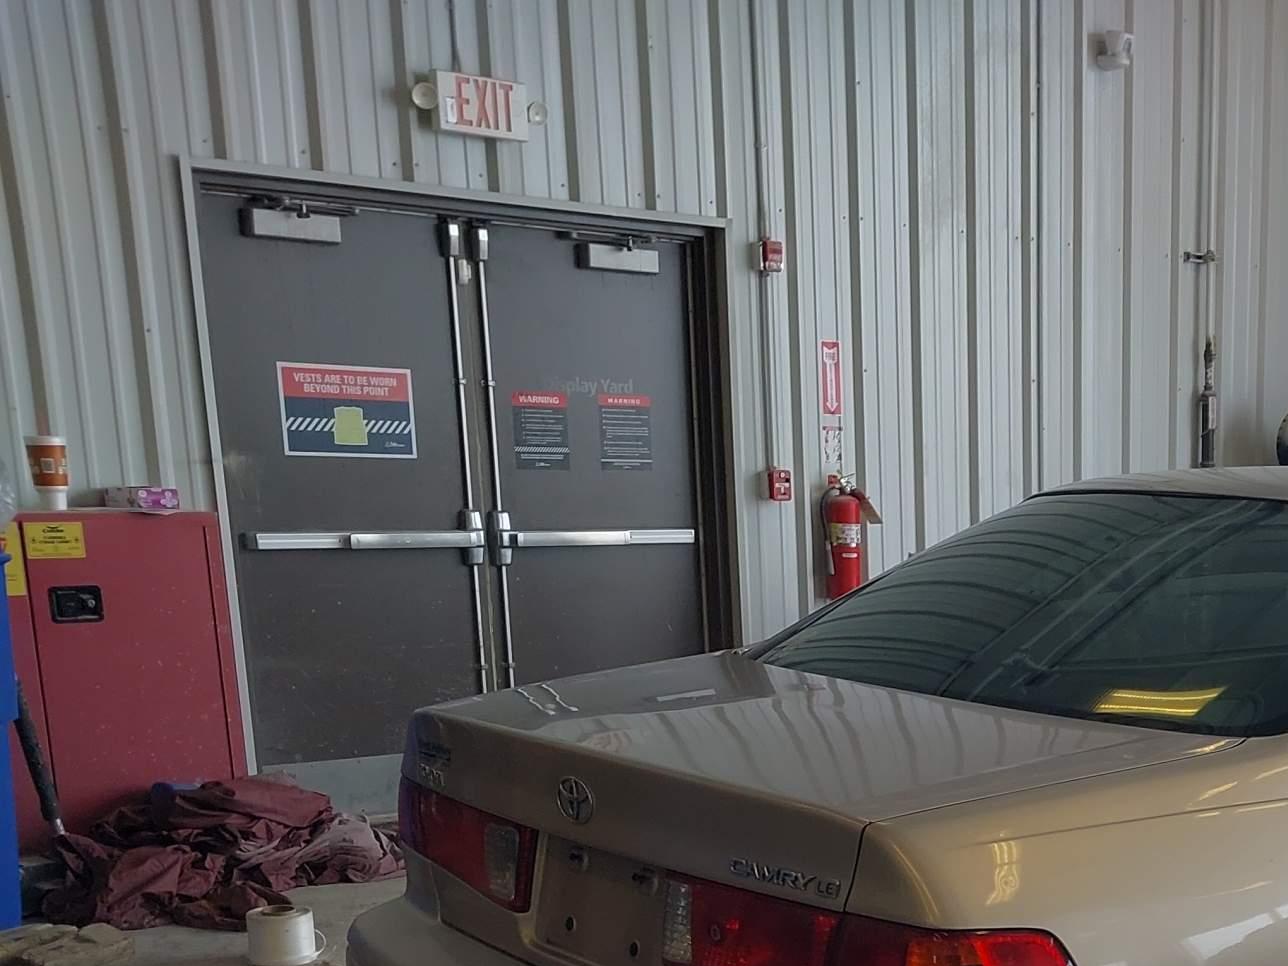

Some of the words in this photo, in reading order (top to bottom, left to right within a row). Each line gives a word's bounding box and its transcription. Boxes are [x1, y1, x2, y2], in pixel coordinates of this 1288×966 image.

[455, 75, 513, 132] EXIT
[293, 372, 322, 383] VESTS
[325, 374, 342, 384] ARE
[344, 375, 354, 385] TO
[355, 376, 368, 386] BE
[370, 377, 397, 387] WORN
[601, 378, 633, 394] Yard
[304, 383, 340, 394] BEYOND
[342, 385, 361, 395] THIS
[364, 386, 390, 396] POINT
[518, 395, 560, 404] WARNING
[730, 857, 816, 891] CAMRY
[816, 879, 841, 899] LE
